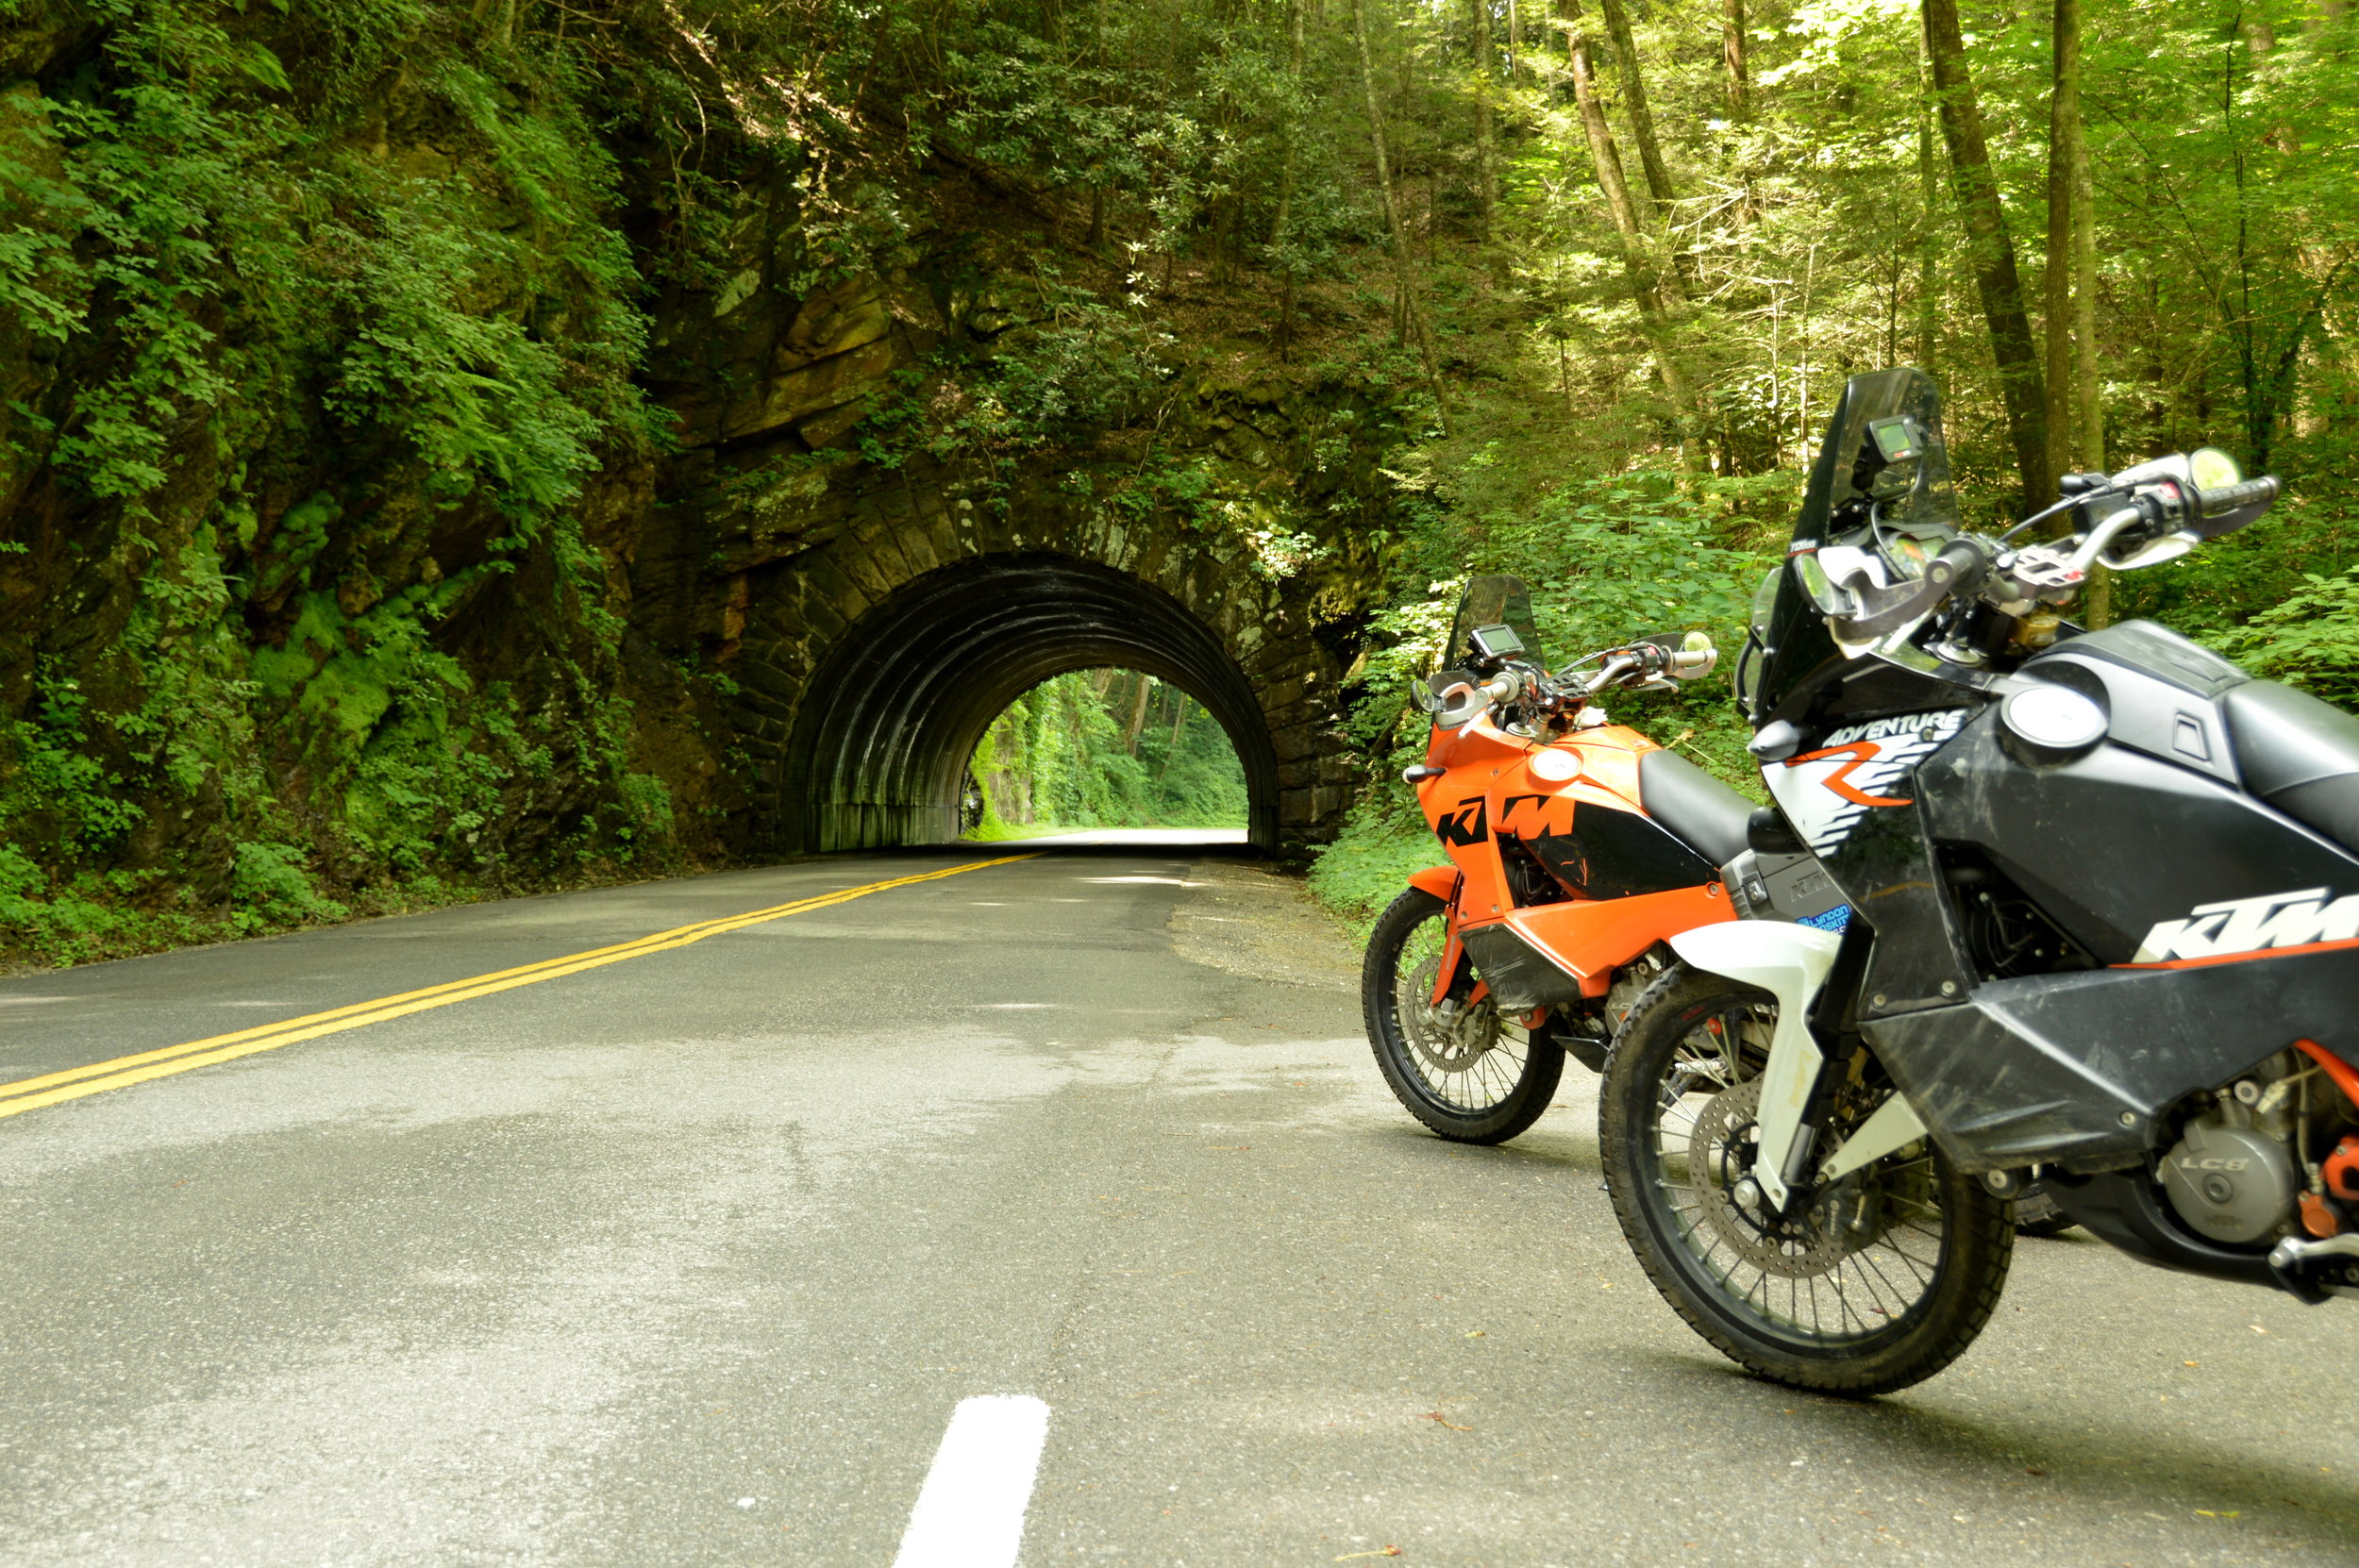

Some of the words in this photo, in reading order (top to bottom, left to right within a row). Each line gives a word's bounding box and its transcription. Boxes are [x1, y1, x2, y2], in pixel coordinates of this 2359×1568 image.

[1822, 709, 1967, 748] ADVENTURE
[1436, 793, 1576, 848] KTM
[2131, 886, 2359, 963] KTM
[2181, 1158, 2250, 1171] LC8
